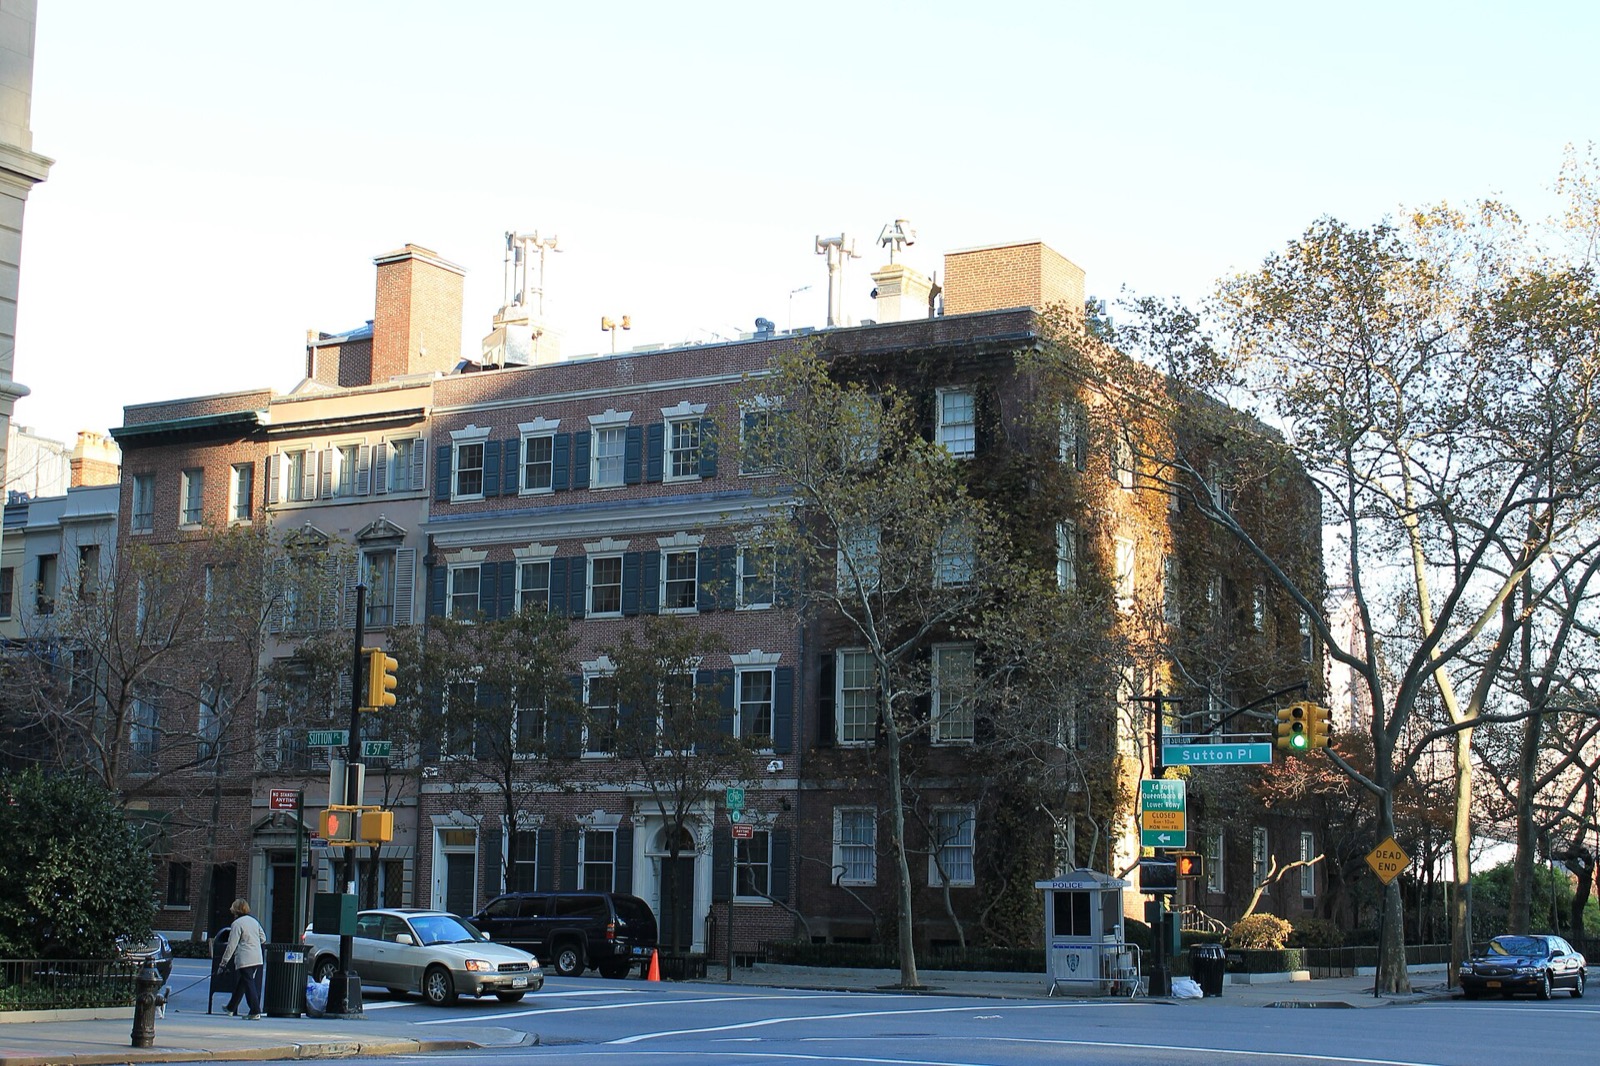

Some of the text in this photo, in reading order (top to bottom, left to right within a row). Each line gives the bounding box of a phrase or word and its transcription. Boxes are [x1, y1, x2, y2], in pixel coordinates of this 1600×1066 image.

[309, 732, 333, 745] SUTTON
[366, 743, 371, 755] E
[372, 743, 382, 755] 57
[1182, 748, 1252, 761] Sutton Pl
[1376, 850, 1402, 860] DEAD
[1378, 862, 1397, 872] END
